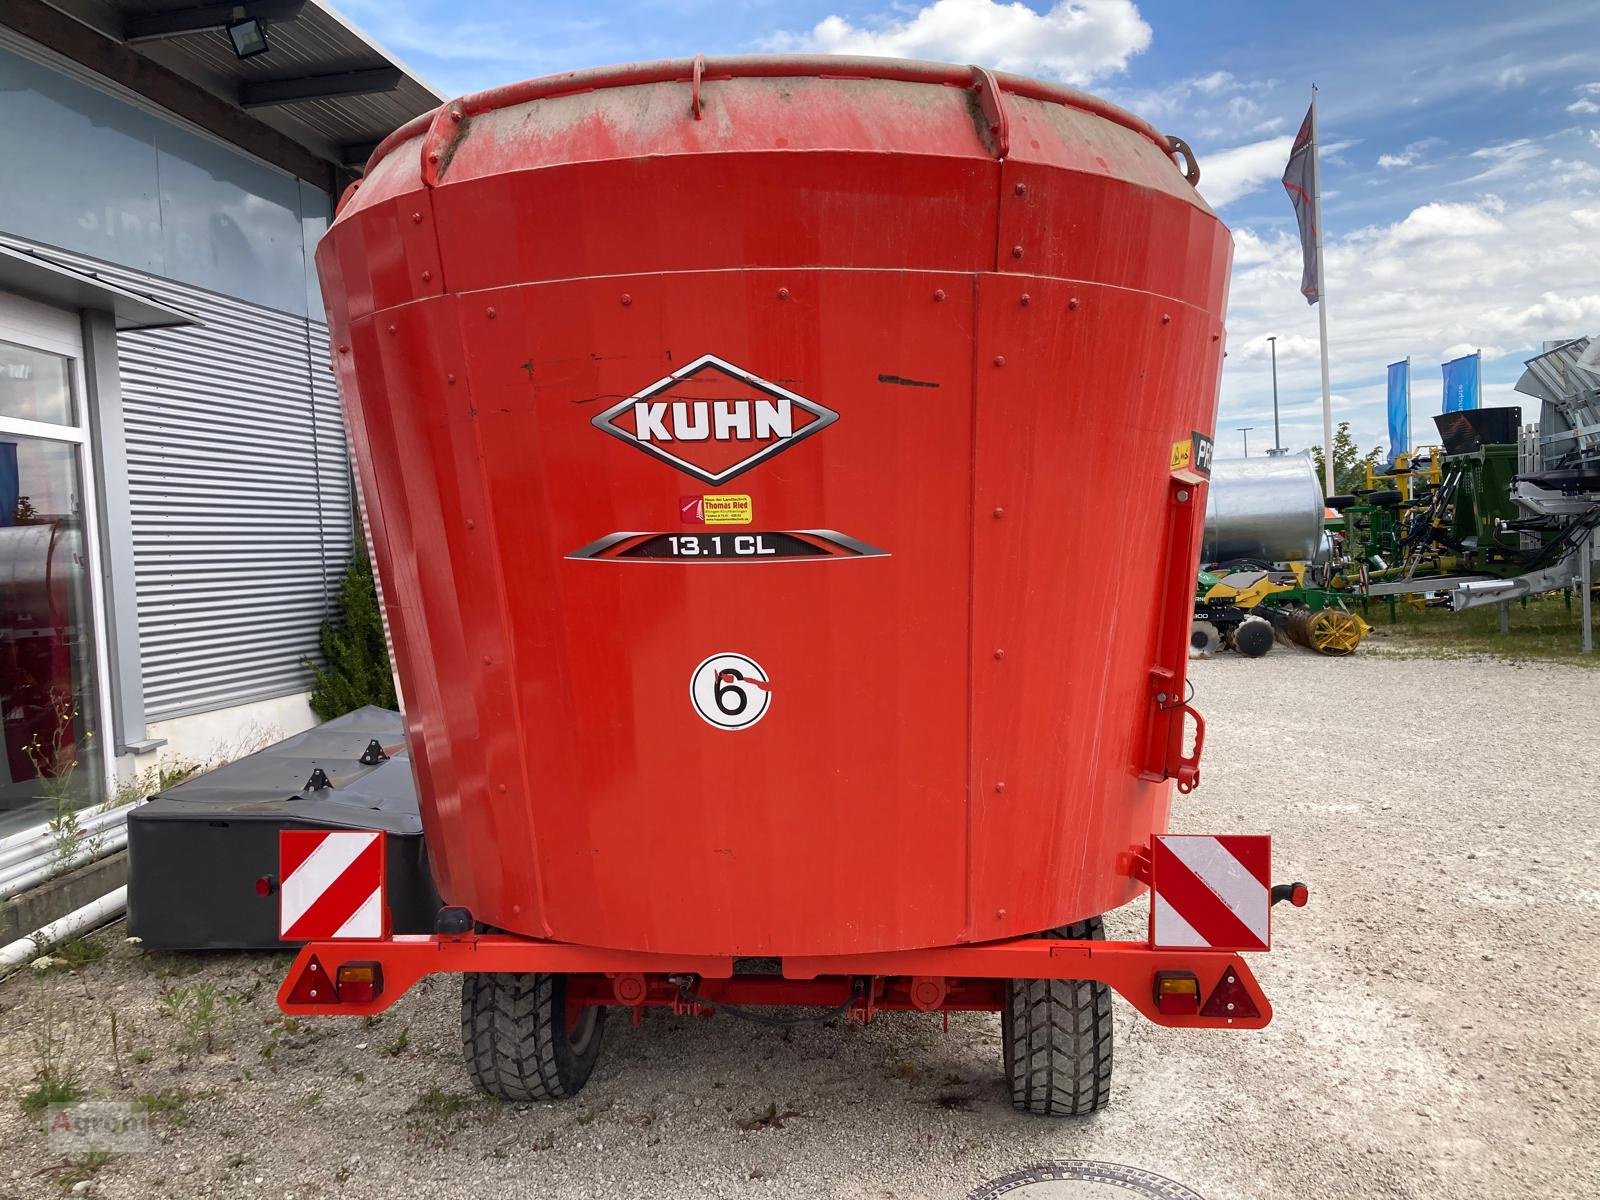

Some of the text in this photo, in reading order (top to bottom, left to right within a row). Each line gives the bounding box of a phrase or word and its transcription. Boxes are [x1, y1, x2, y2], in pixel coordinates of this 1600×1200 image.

[635, 399, 793, 441] KUHN
[1197, 440, 1213, 470] PR
[732, 501, 748, 509] Ried
[668, 535, 776, 555] 13.1 CL
[714, 668, 748, 716] 6
